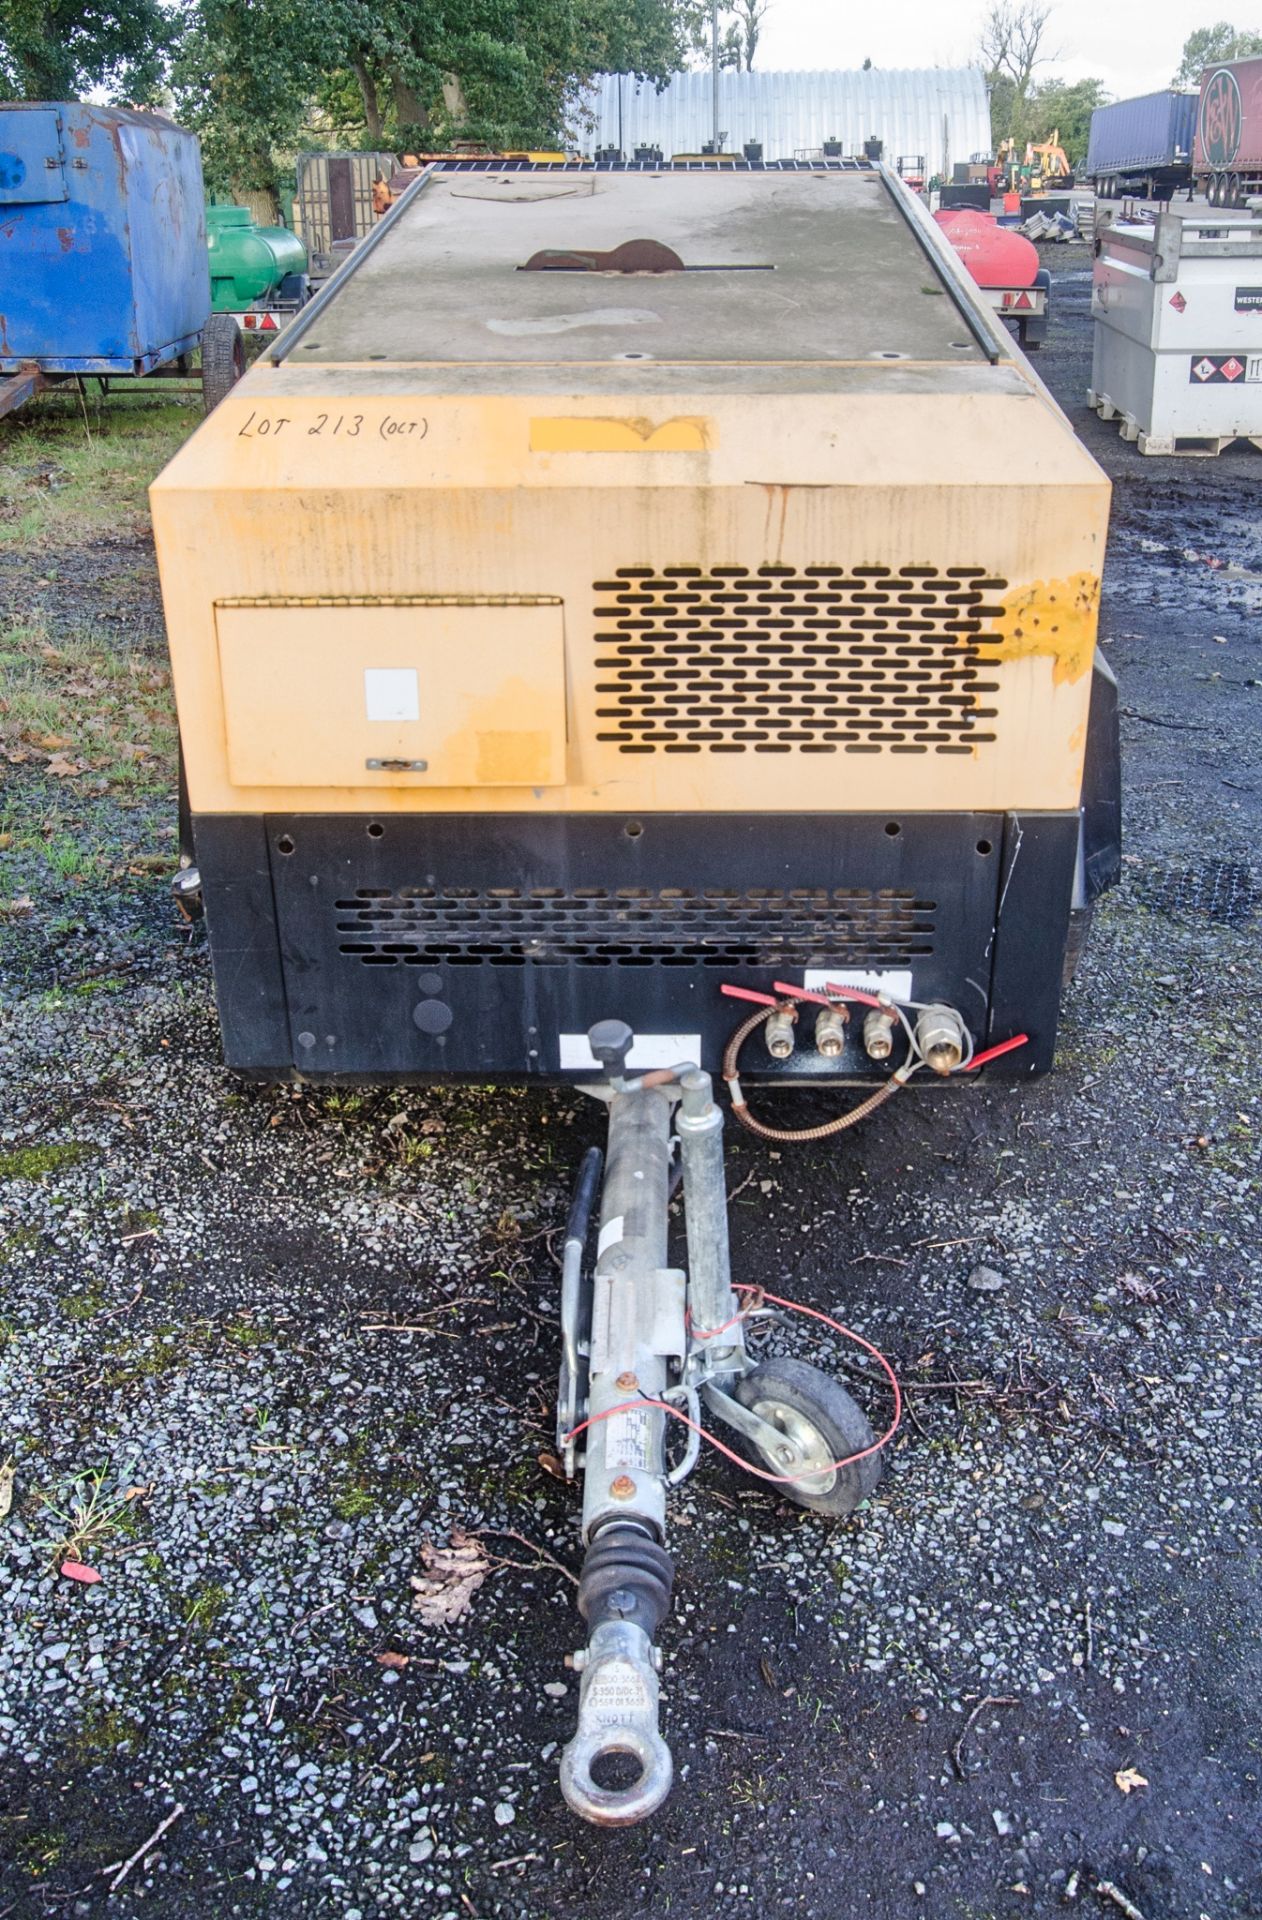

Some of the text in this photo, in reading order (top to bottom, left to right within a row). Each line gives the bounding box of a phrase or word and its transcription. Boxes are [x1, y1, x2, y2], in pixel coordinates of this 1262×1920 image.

[238, 411, 429, 440] LOT 213 (OCT)
